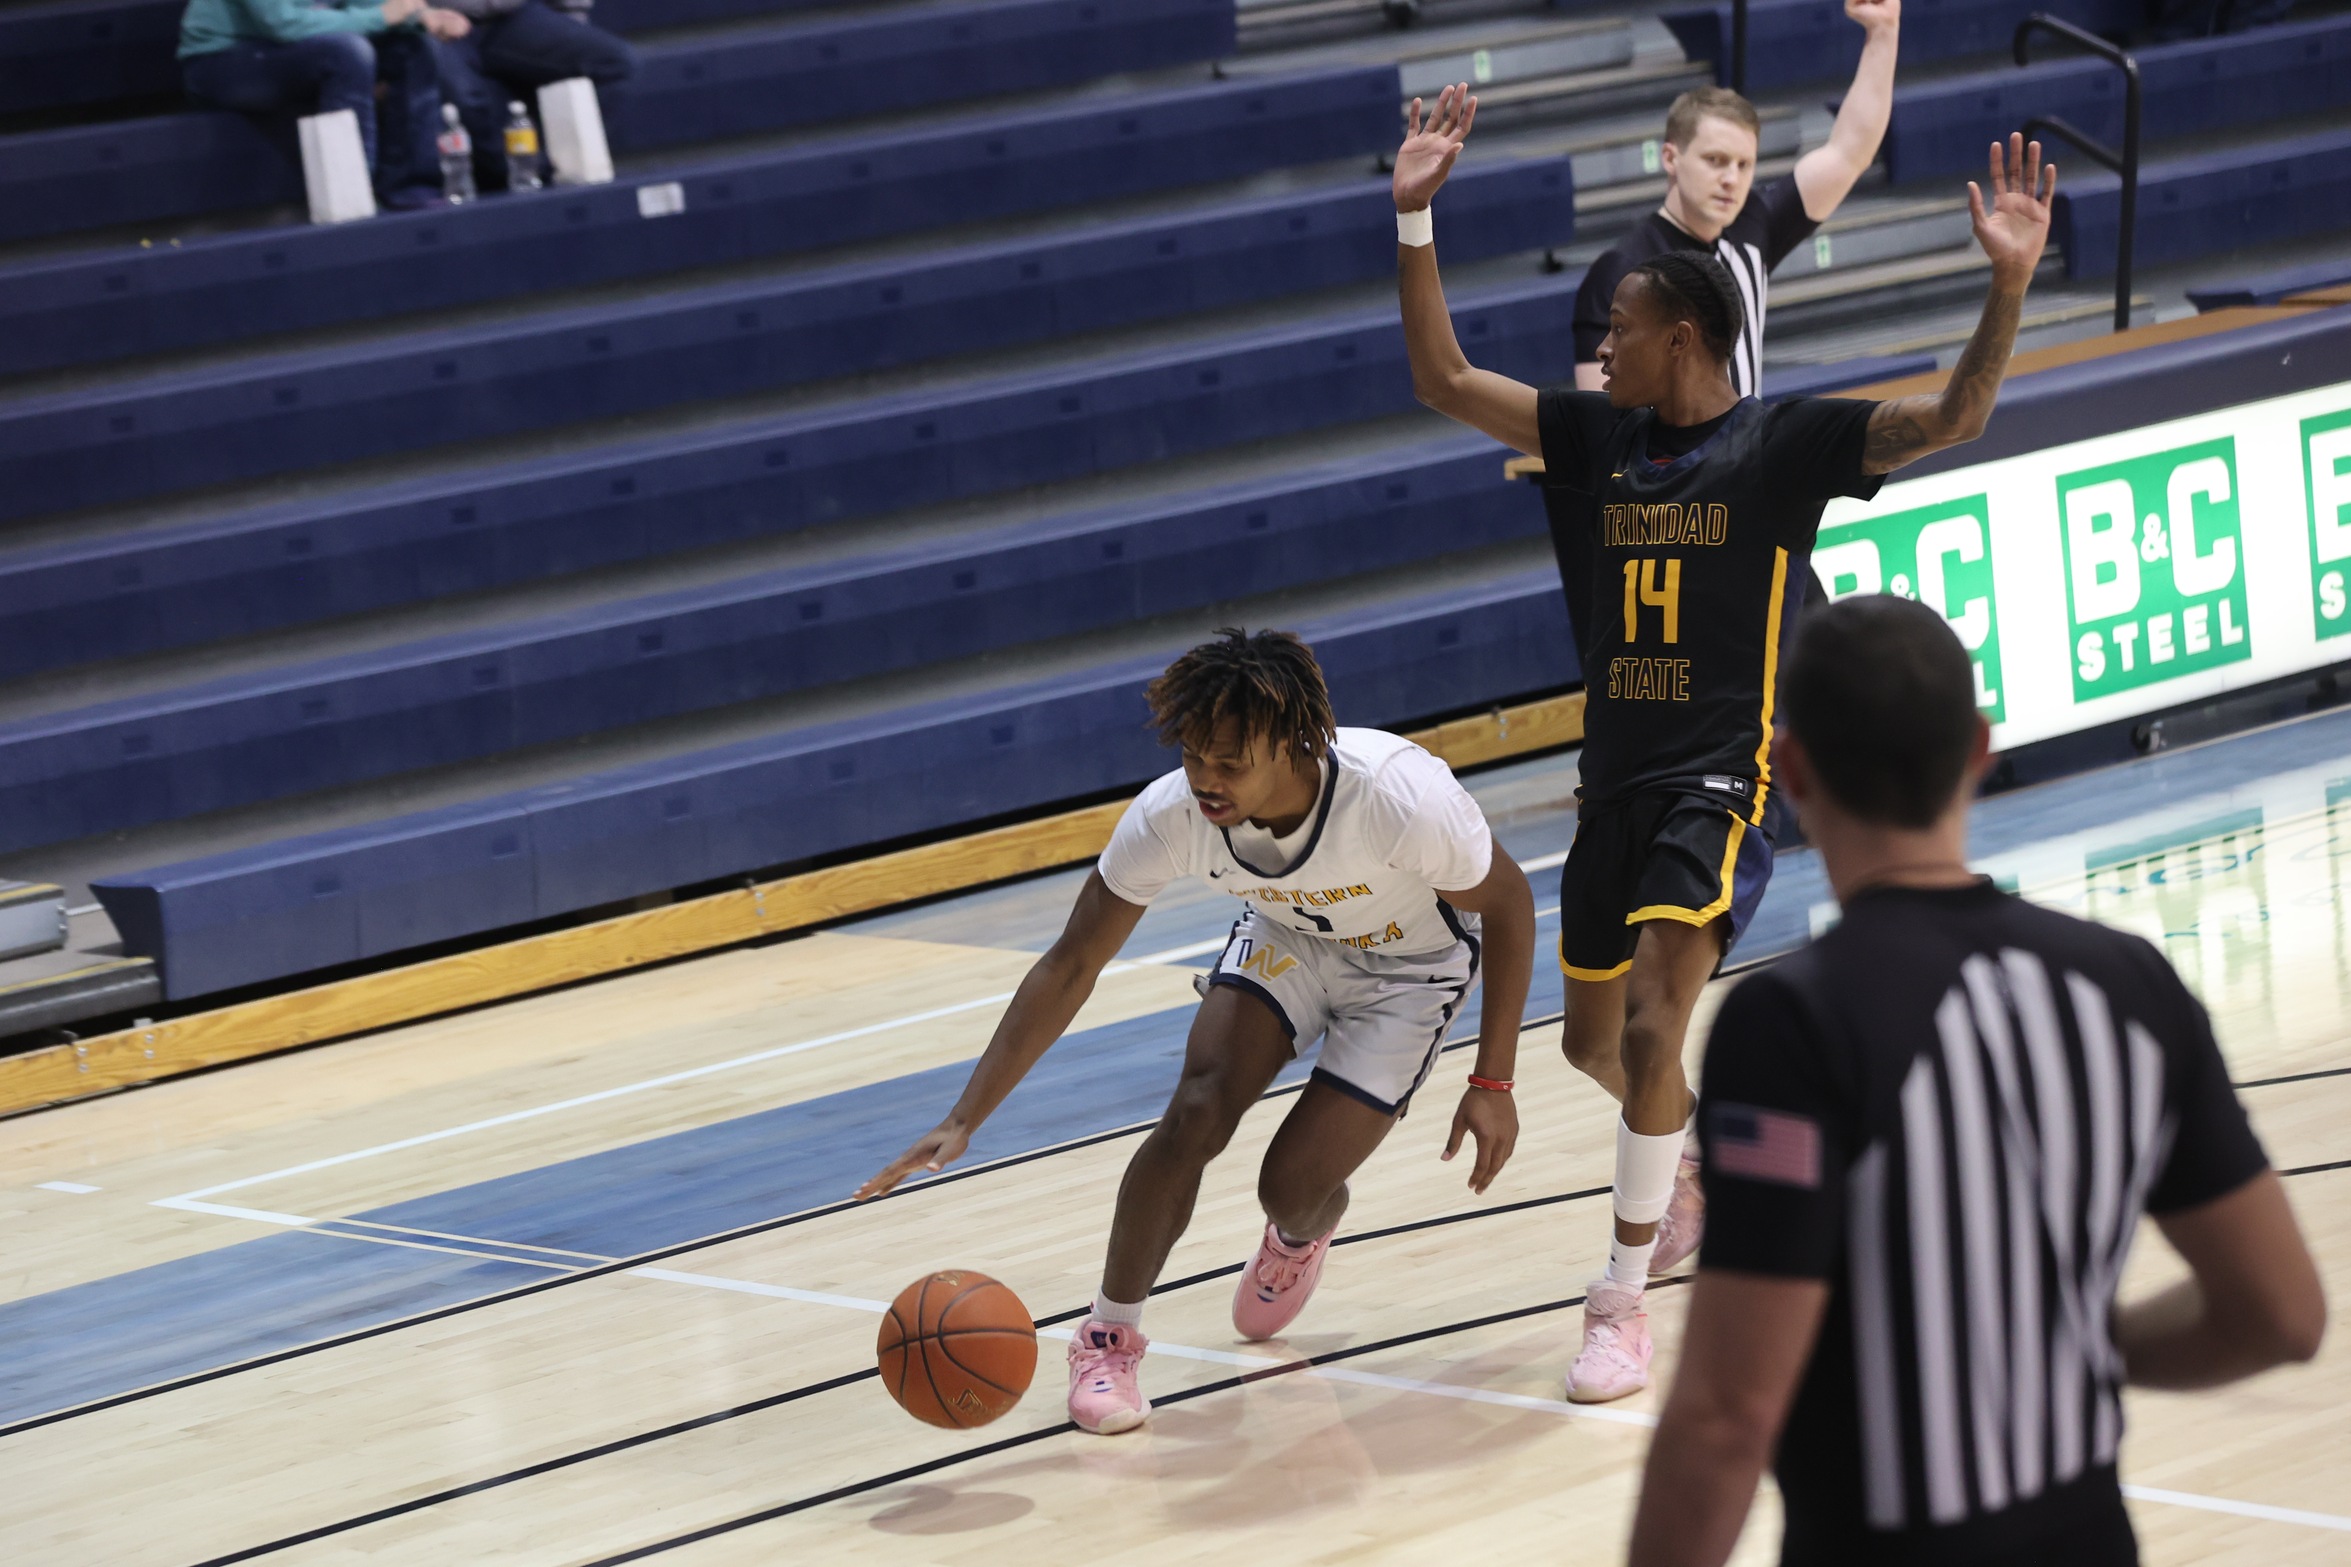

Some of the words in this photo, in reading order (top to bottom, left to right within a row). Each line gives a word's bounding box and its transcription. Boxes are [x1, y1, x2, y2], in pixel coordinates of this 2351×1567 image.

[1603, 503, 1728, 547] TRINIDAD
[2065, 455, 2237, 625] B&C
[1623, 558, 1682, 644] 14
[2077, 597, 2244, 682] STEEL
[1608, 657, 1691, 701] STATE
